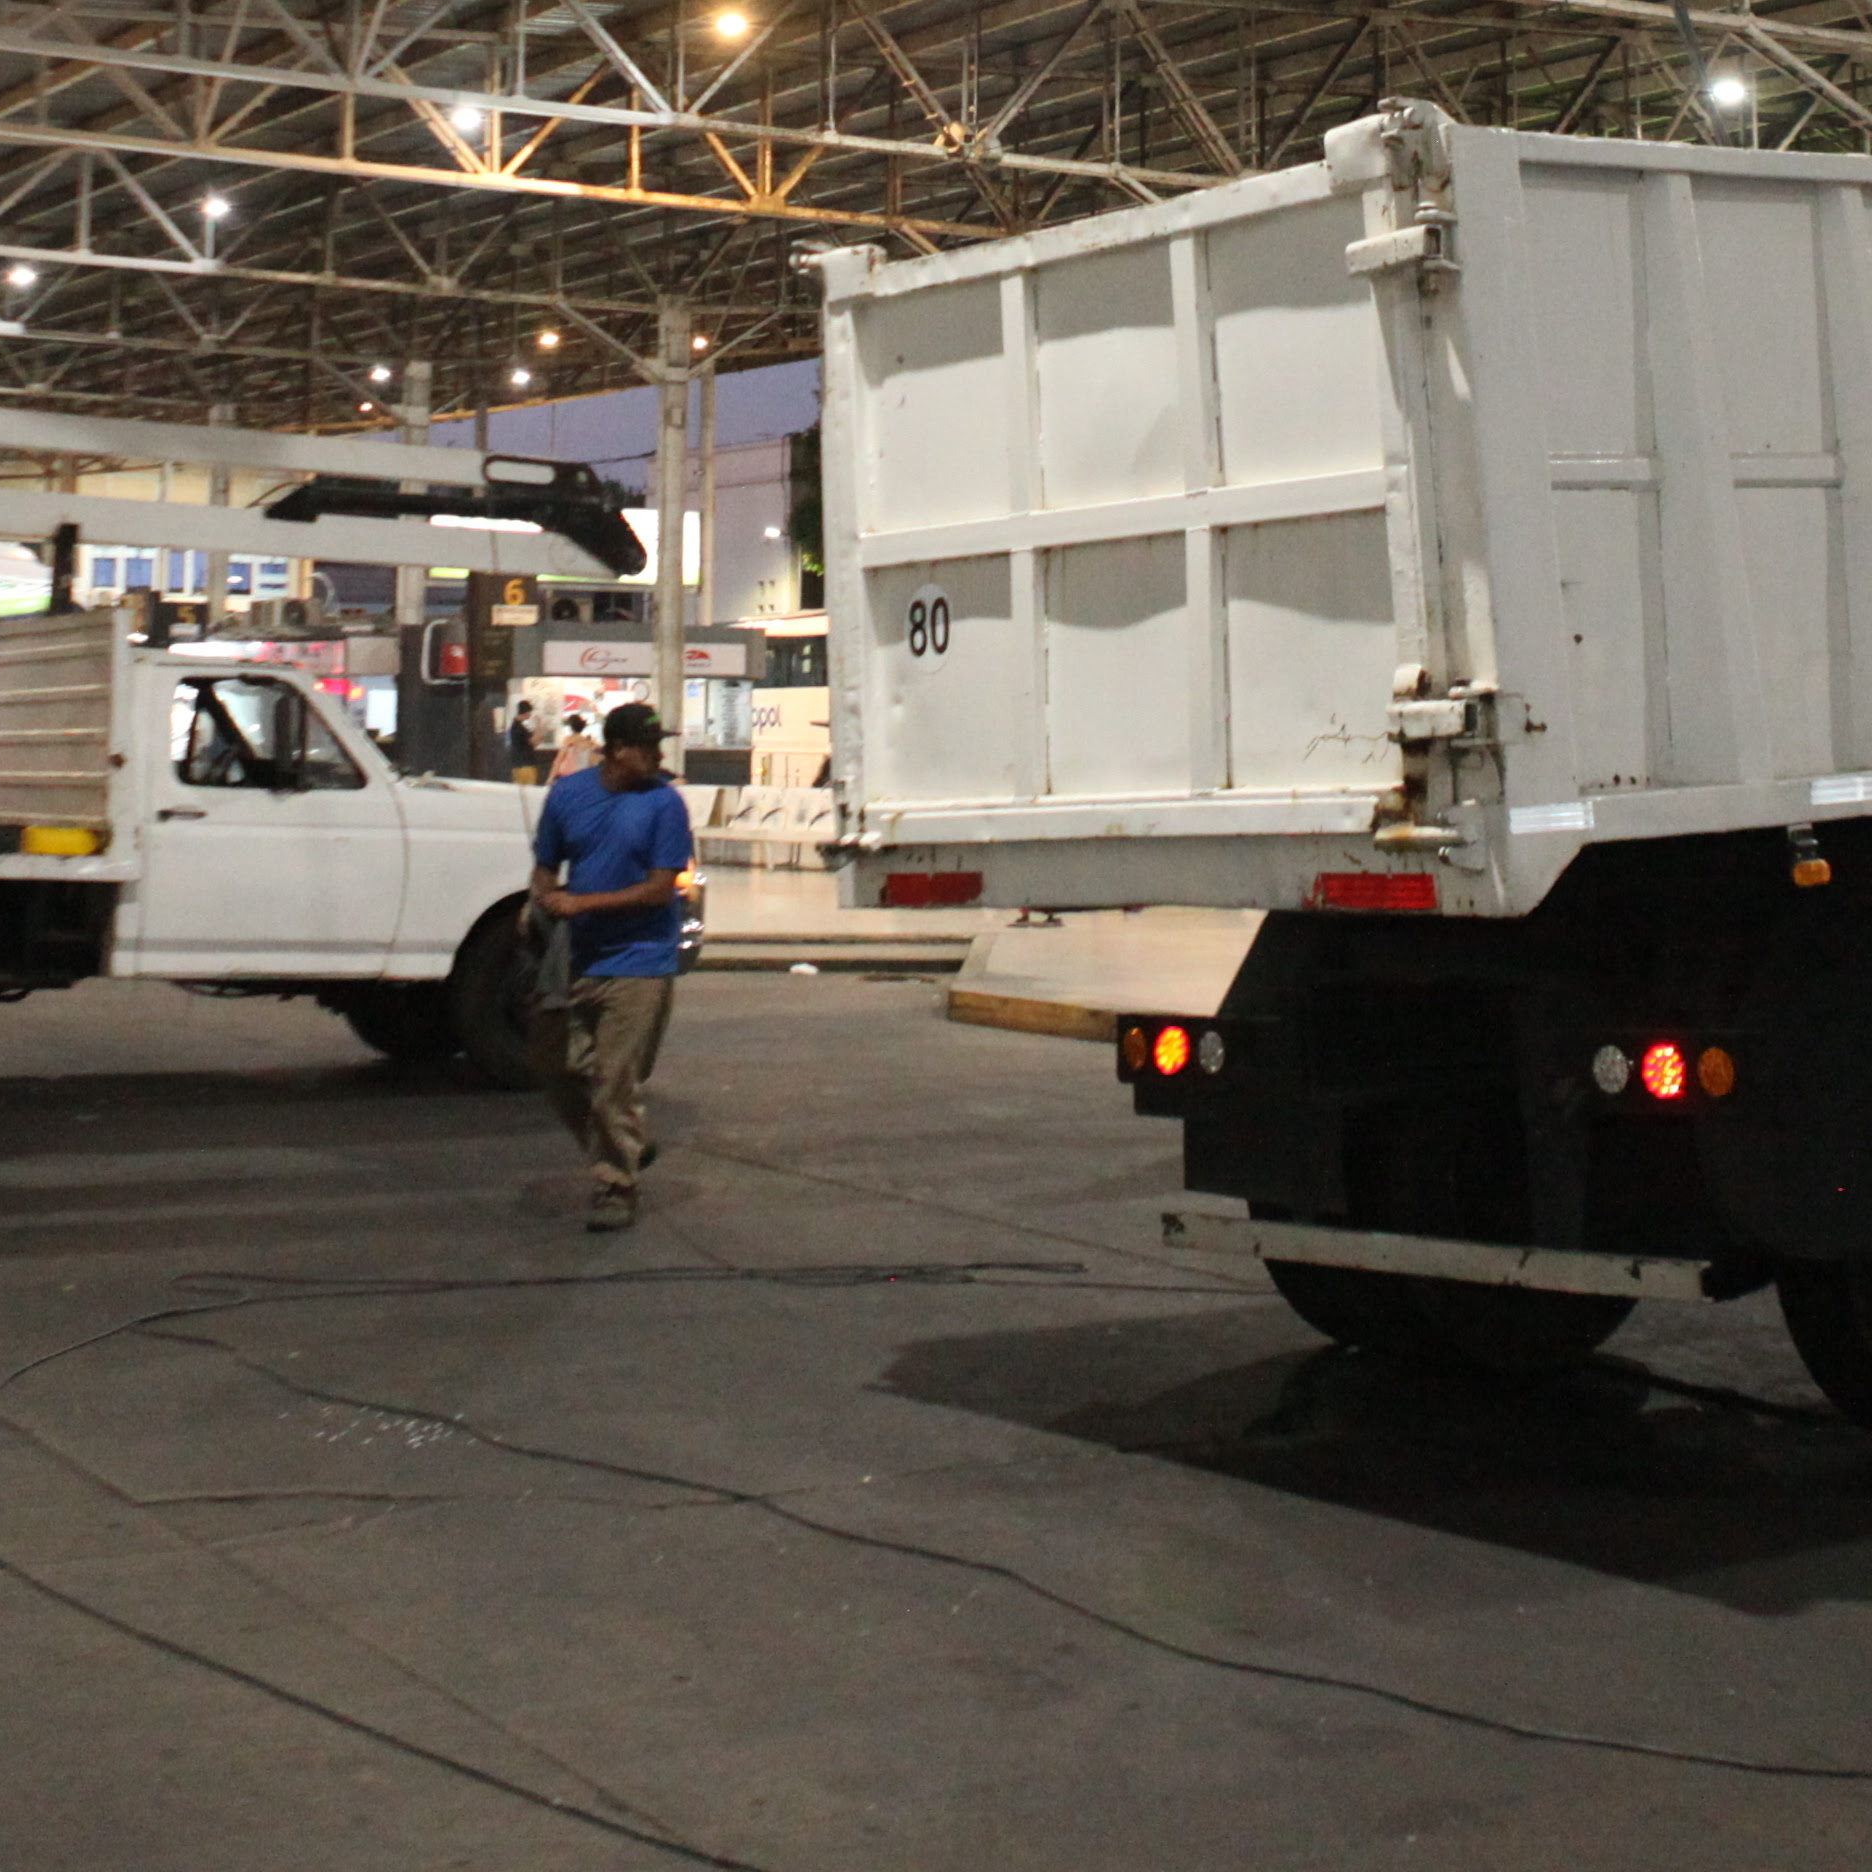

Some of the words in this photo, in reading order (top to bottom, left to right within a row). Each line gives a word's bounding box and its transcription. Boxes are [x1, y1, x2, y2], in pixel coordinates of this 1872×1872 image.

[503, 578, 527, 606] 6
[909, 597, 949, 657] 80
[751, 704, 781, 736] opol
